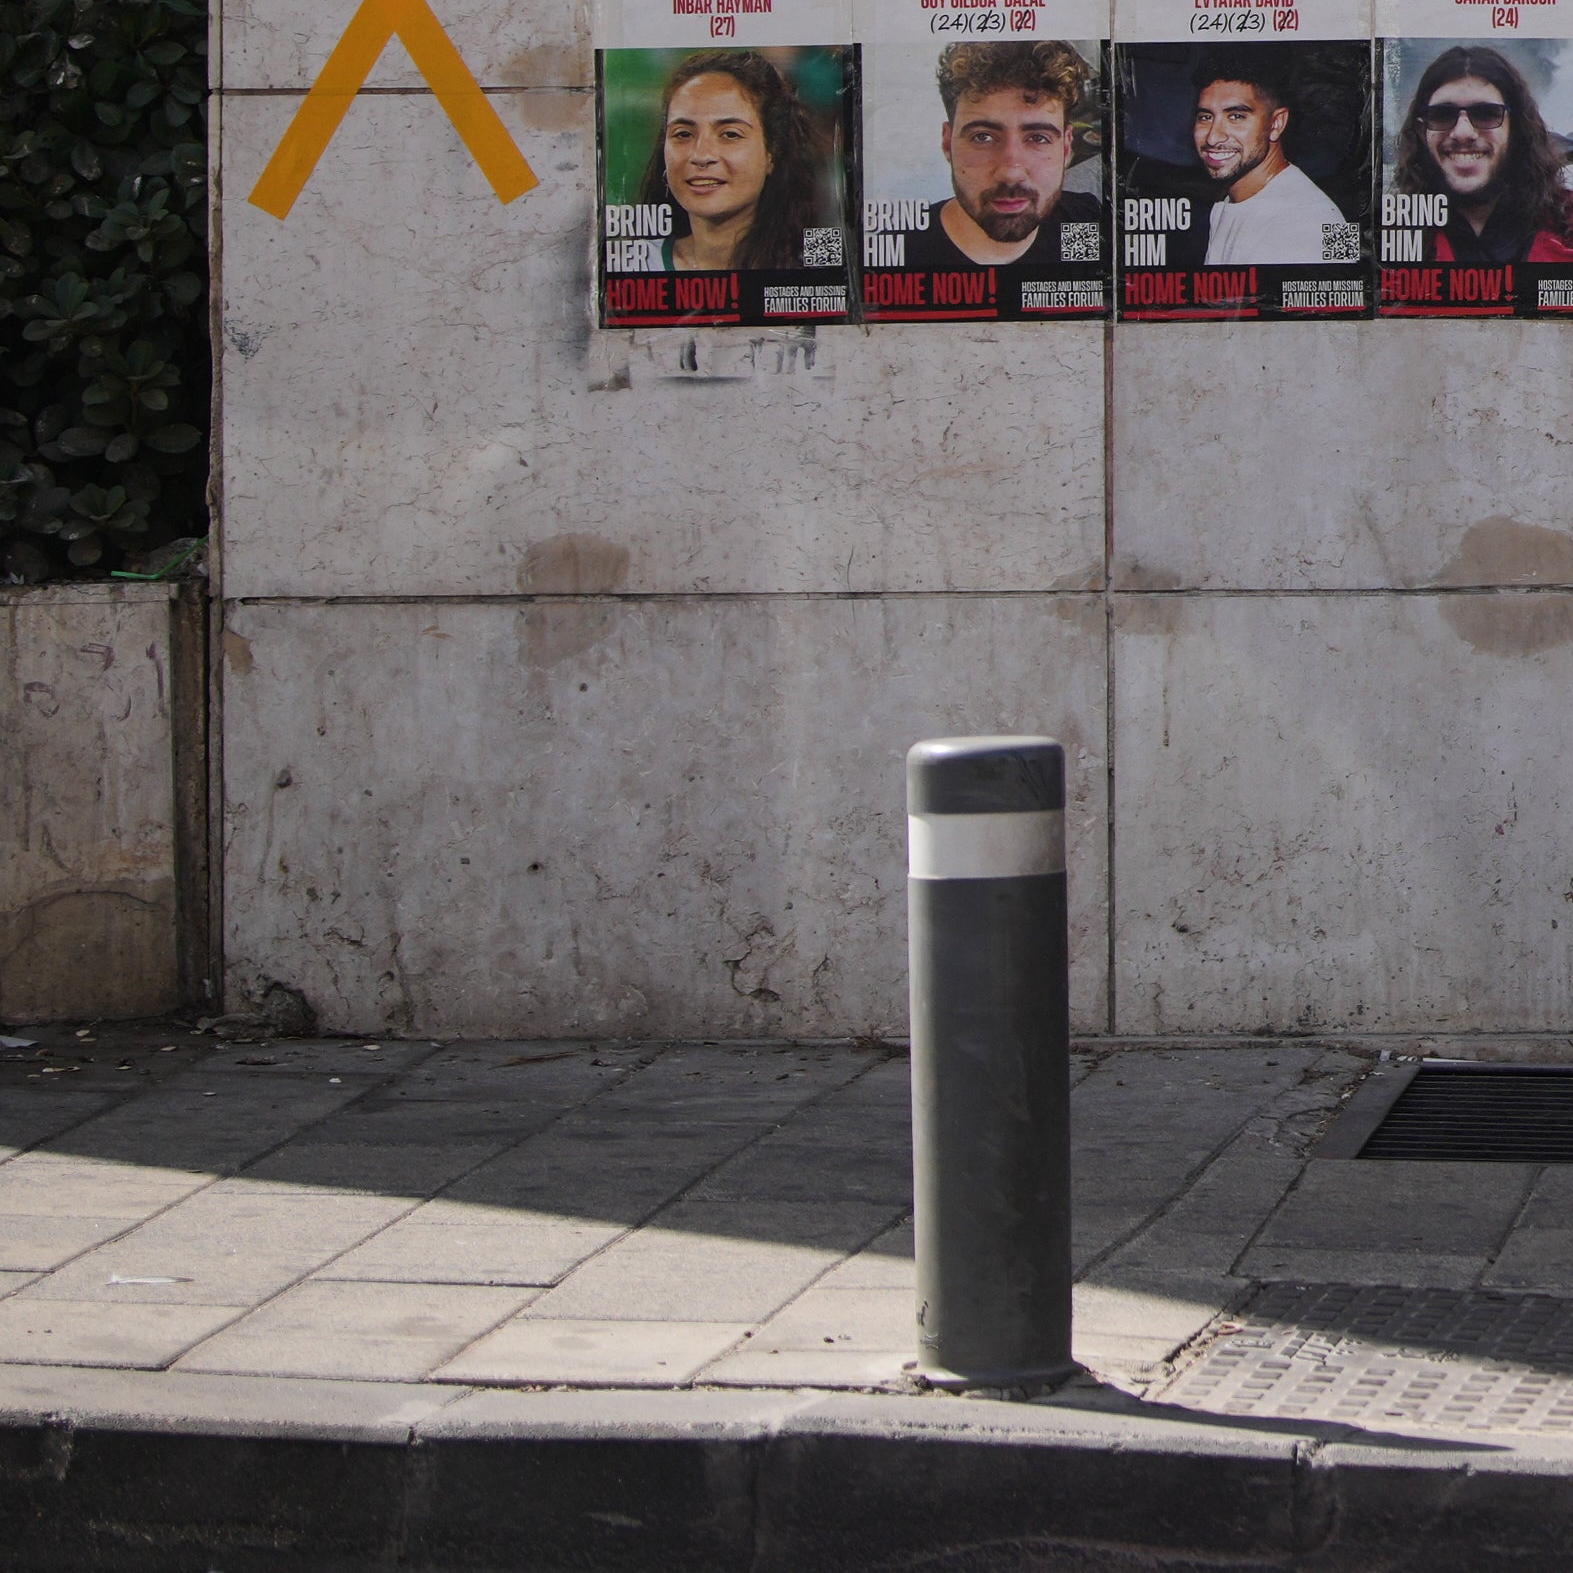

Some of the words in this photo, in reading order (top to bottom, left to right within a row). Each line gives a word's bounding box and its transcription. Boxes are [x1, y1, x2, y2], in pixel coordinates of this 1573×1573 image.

[709, 15, 737, 37] (27)
[605, 203, 673, 237] BRING
[606, 239, 650, 272] HER
[606, 278, 669, 311] HOME
